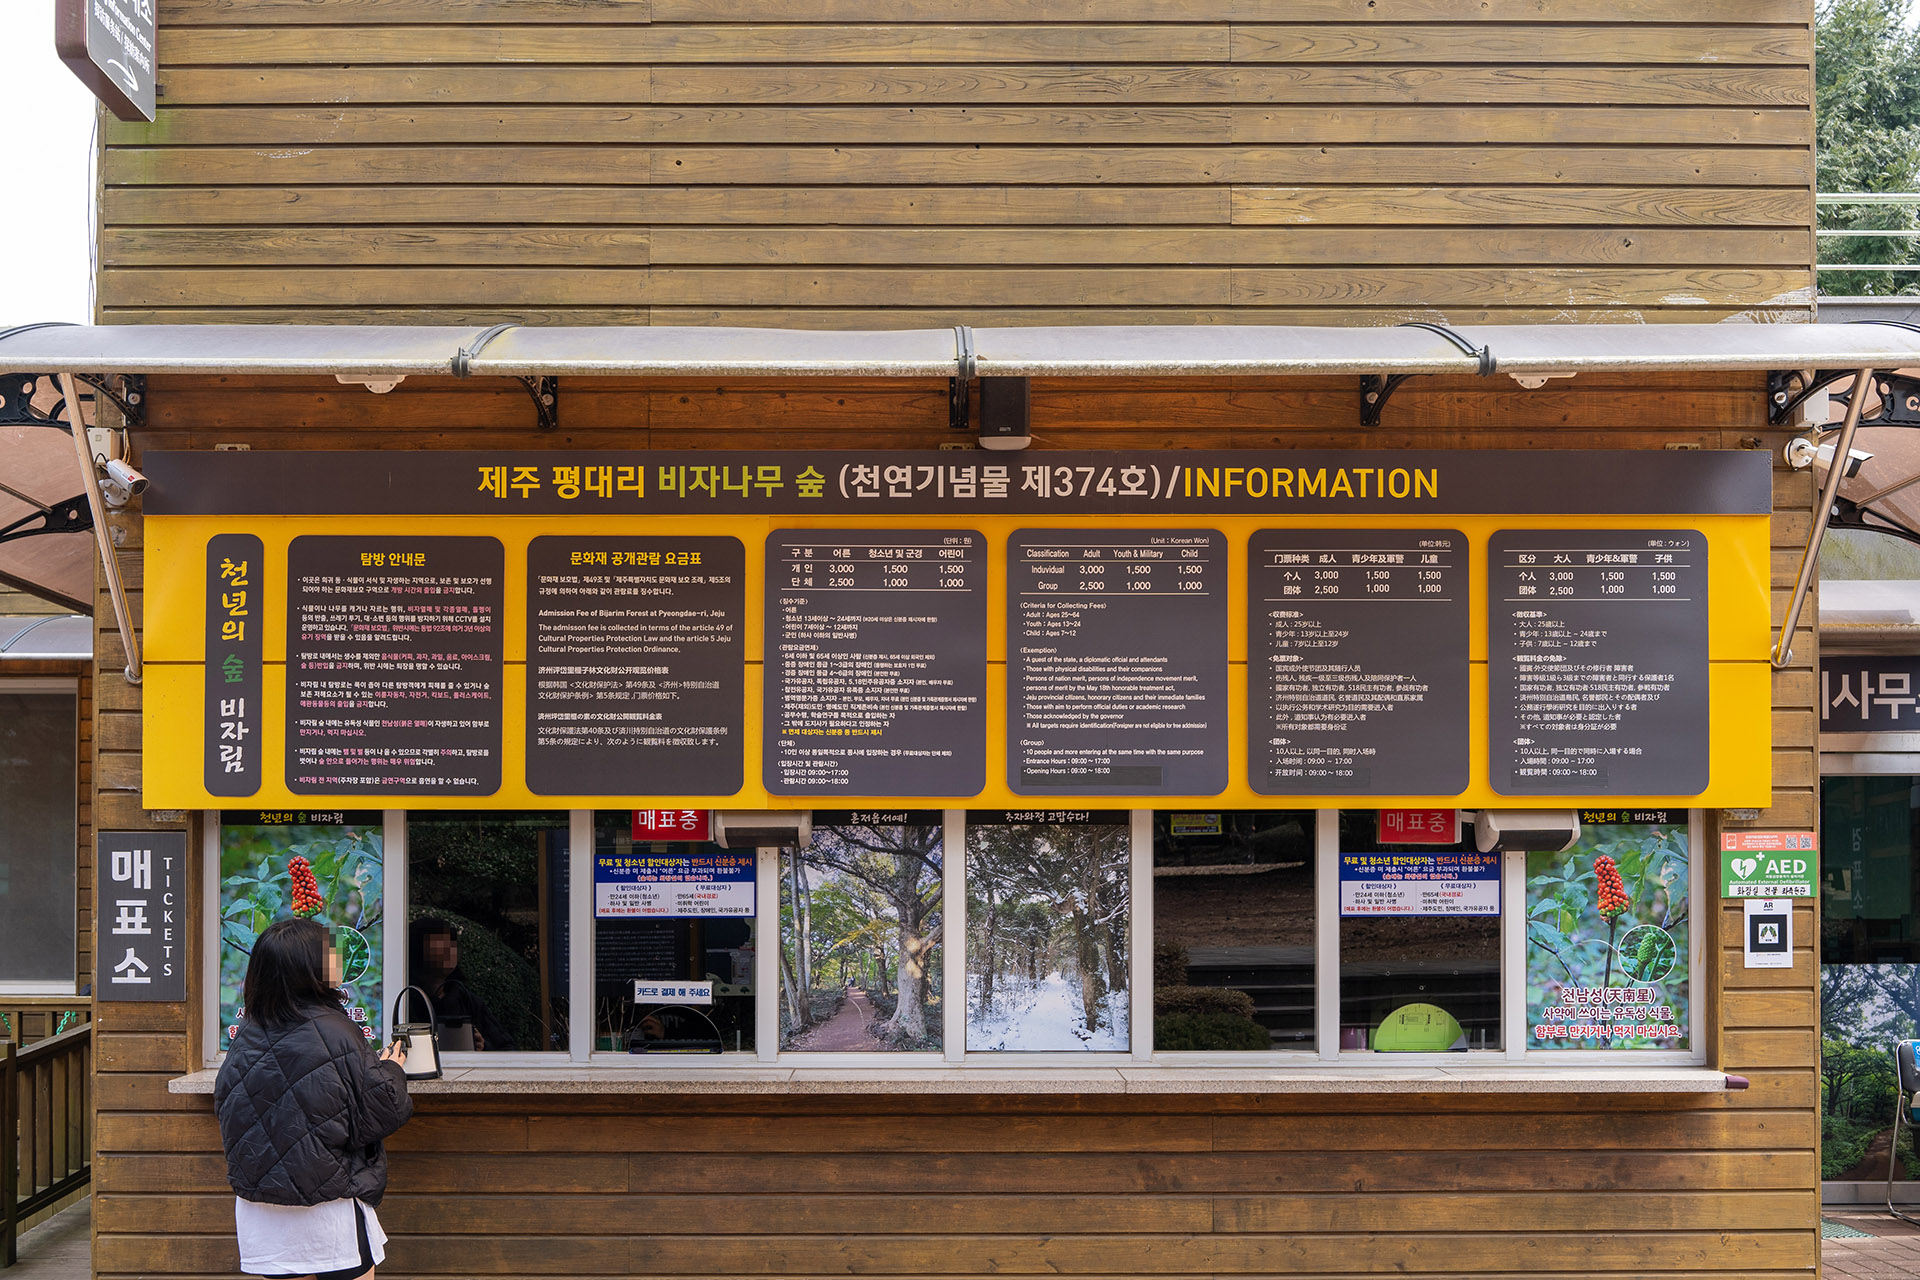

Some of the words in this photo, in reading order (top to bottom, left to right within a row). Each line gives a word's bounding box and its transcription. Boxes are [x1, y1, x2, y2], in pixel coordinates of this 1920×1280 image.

[477, 466, 541, 499] 제주
[551, 466, 644, 499] 평대리
[658, 466, 785, 498] 비자나무
[795, 465, 826, 498] 숲
[838, 464, 1010, 499] (천연기념물
[1150, 537, 1165, 545] (Unit
[1194, 537, 1209, 545] Won)
[360, 552, 385, 566] 탐방
[389, 553, 426, 566] 안내문
[570, 552, 607, 565] 문화재
[611, 552, 660, 565] 공개관람
[665, 552, 702, 565] 요금표
[833, 549, 851, 558] 어른
[868, 549, 893, 558] 청소년
[895, 549, 904, 558] 및
[906, 549, 923, 558] 군경
[939, 549, 964, 558] 어린이
[1027, 549, 1069, 558] Classification
[1083, 549, 1100, 558] Adult
[1113, 549, 1131, 558] Youth
[1132, 550, 1139, 558] &
[1140, 549, 1163, 559] Military
[1181, 549, 1198, 558] Child
[1274, 554, 1310, 563] 门票种类
[1319, 554, 1336, 563] 成人
[1421, 554, 1438, 564] 儿童
[1519, 554, 1537, 563] 区分
[1554, 554, 1571, 563] 大人
[1655, 554, 1673, 563] 子供
[829, 565, 855, 574] 3,000
[883, 565, 908, 574] 1,500
[939, 565, 964, 574] 1,500
[1031, 565, 1064, 574] Induvidual
[1079, 566, 1104, 575] 3,000
[1126, 566, 1151, 575] 1,500
[1178, 566, 1202, 575] 1,500
[1284, 572, 1301, 581] 个人
[1314, 571, 1339, 581] 3,000
[1366, 571, 1390, 581] 1,500
[1417, 571, 1441, 581] 1,500
[1549, 572, 1574, 581] 3,000
[1601, 572, 1624, 581] 1,500
[1652, 572, 1676, 581] 1,500
[829, 578, 855, 587] 2,500
[883, 578, 908, 588] 1,000
[939, 579, 964, 588] 1,000
[1038, 582, 1058, 591] Group
[1079, 582, 1104, 591] 2,500
[1126, 582, 1151, 591] 1,000
[1178, 582, 1202, 591] 1,000
[1284, 586, 1302, 595] 团体
[1314, 585, 1339, 595] 2,500
[1366, 584, 1390, 594] 1,000
[1417, 584, 1441, 594] 1,000
[1549, 586, 1574, 596] 2,500
[1601, 585, 1624, 594] 1,000
[1652, 585, 1676, 594] 1,000
[220, 558, 248, 641] 천년의
[539, 609, 575, 617] Admission
[576, 609, 589, 617] Fee
[591, 609, 598, 617] of
[600, 609, 625, 618] Bijarim
[626, 609, 649, 617] Forest
[650, 609, 657, 617] at
[710, 609, 725, 618] Jeju
[568, 645, 604, 653] Properties
[222, 654, 244, 683] 숲
[219, 698, 249, 773] 비자림
[260, 811, 293, 824] 천년의
[298, 811, 306, 824] 숲
[311, 812, 344, 824] 비자림
[639, 810, 698, 830] 매표중
[1047, 811, 1089, 823] 고맙수다!
[1387, 812, 1446, 832] 매표중
[1583, 811, 1616, 823] 천년의
[1621, 811, 1630, 823] 숲
[1634, 812, 1667, 823] 비자림
[599, 858, 613, 867] 무료
[615, 858, 622, 867] 및
[624, 858, 645, 867] 청소년
[647, 858, 690, 867] 할인대상자는
[692, 858, 713, 867] 반드시
[714, 856, 736, 867] 신분증
[737, 858, 753, 867] 제시
[1765, 859, 1807, 874] AED
[112, 850, 151, 984] 매표소
[163, 857, 173, 977] TICKETS
[637, 988, 658, 996] 카드로
[661, 988, 675, 996] 결제
[678, 988, 686, 996] 해
[689, 988, 710, 996] 주세요
[1543, 1007, 1576, 1020] 사약에
[1578, 1007, 1611, 1020] 쓰이는
[1613, 1007, 1646, 1020] 유독성
[1649, 1007, 1674, 1020] 식물.
[1536, 1025, 1567, 1038] 함부로
[1570, 1025, 1612, 1038] 만지거나
[1614, 1025, 1635, 1038] 먹지
